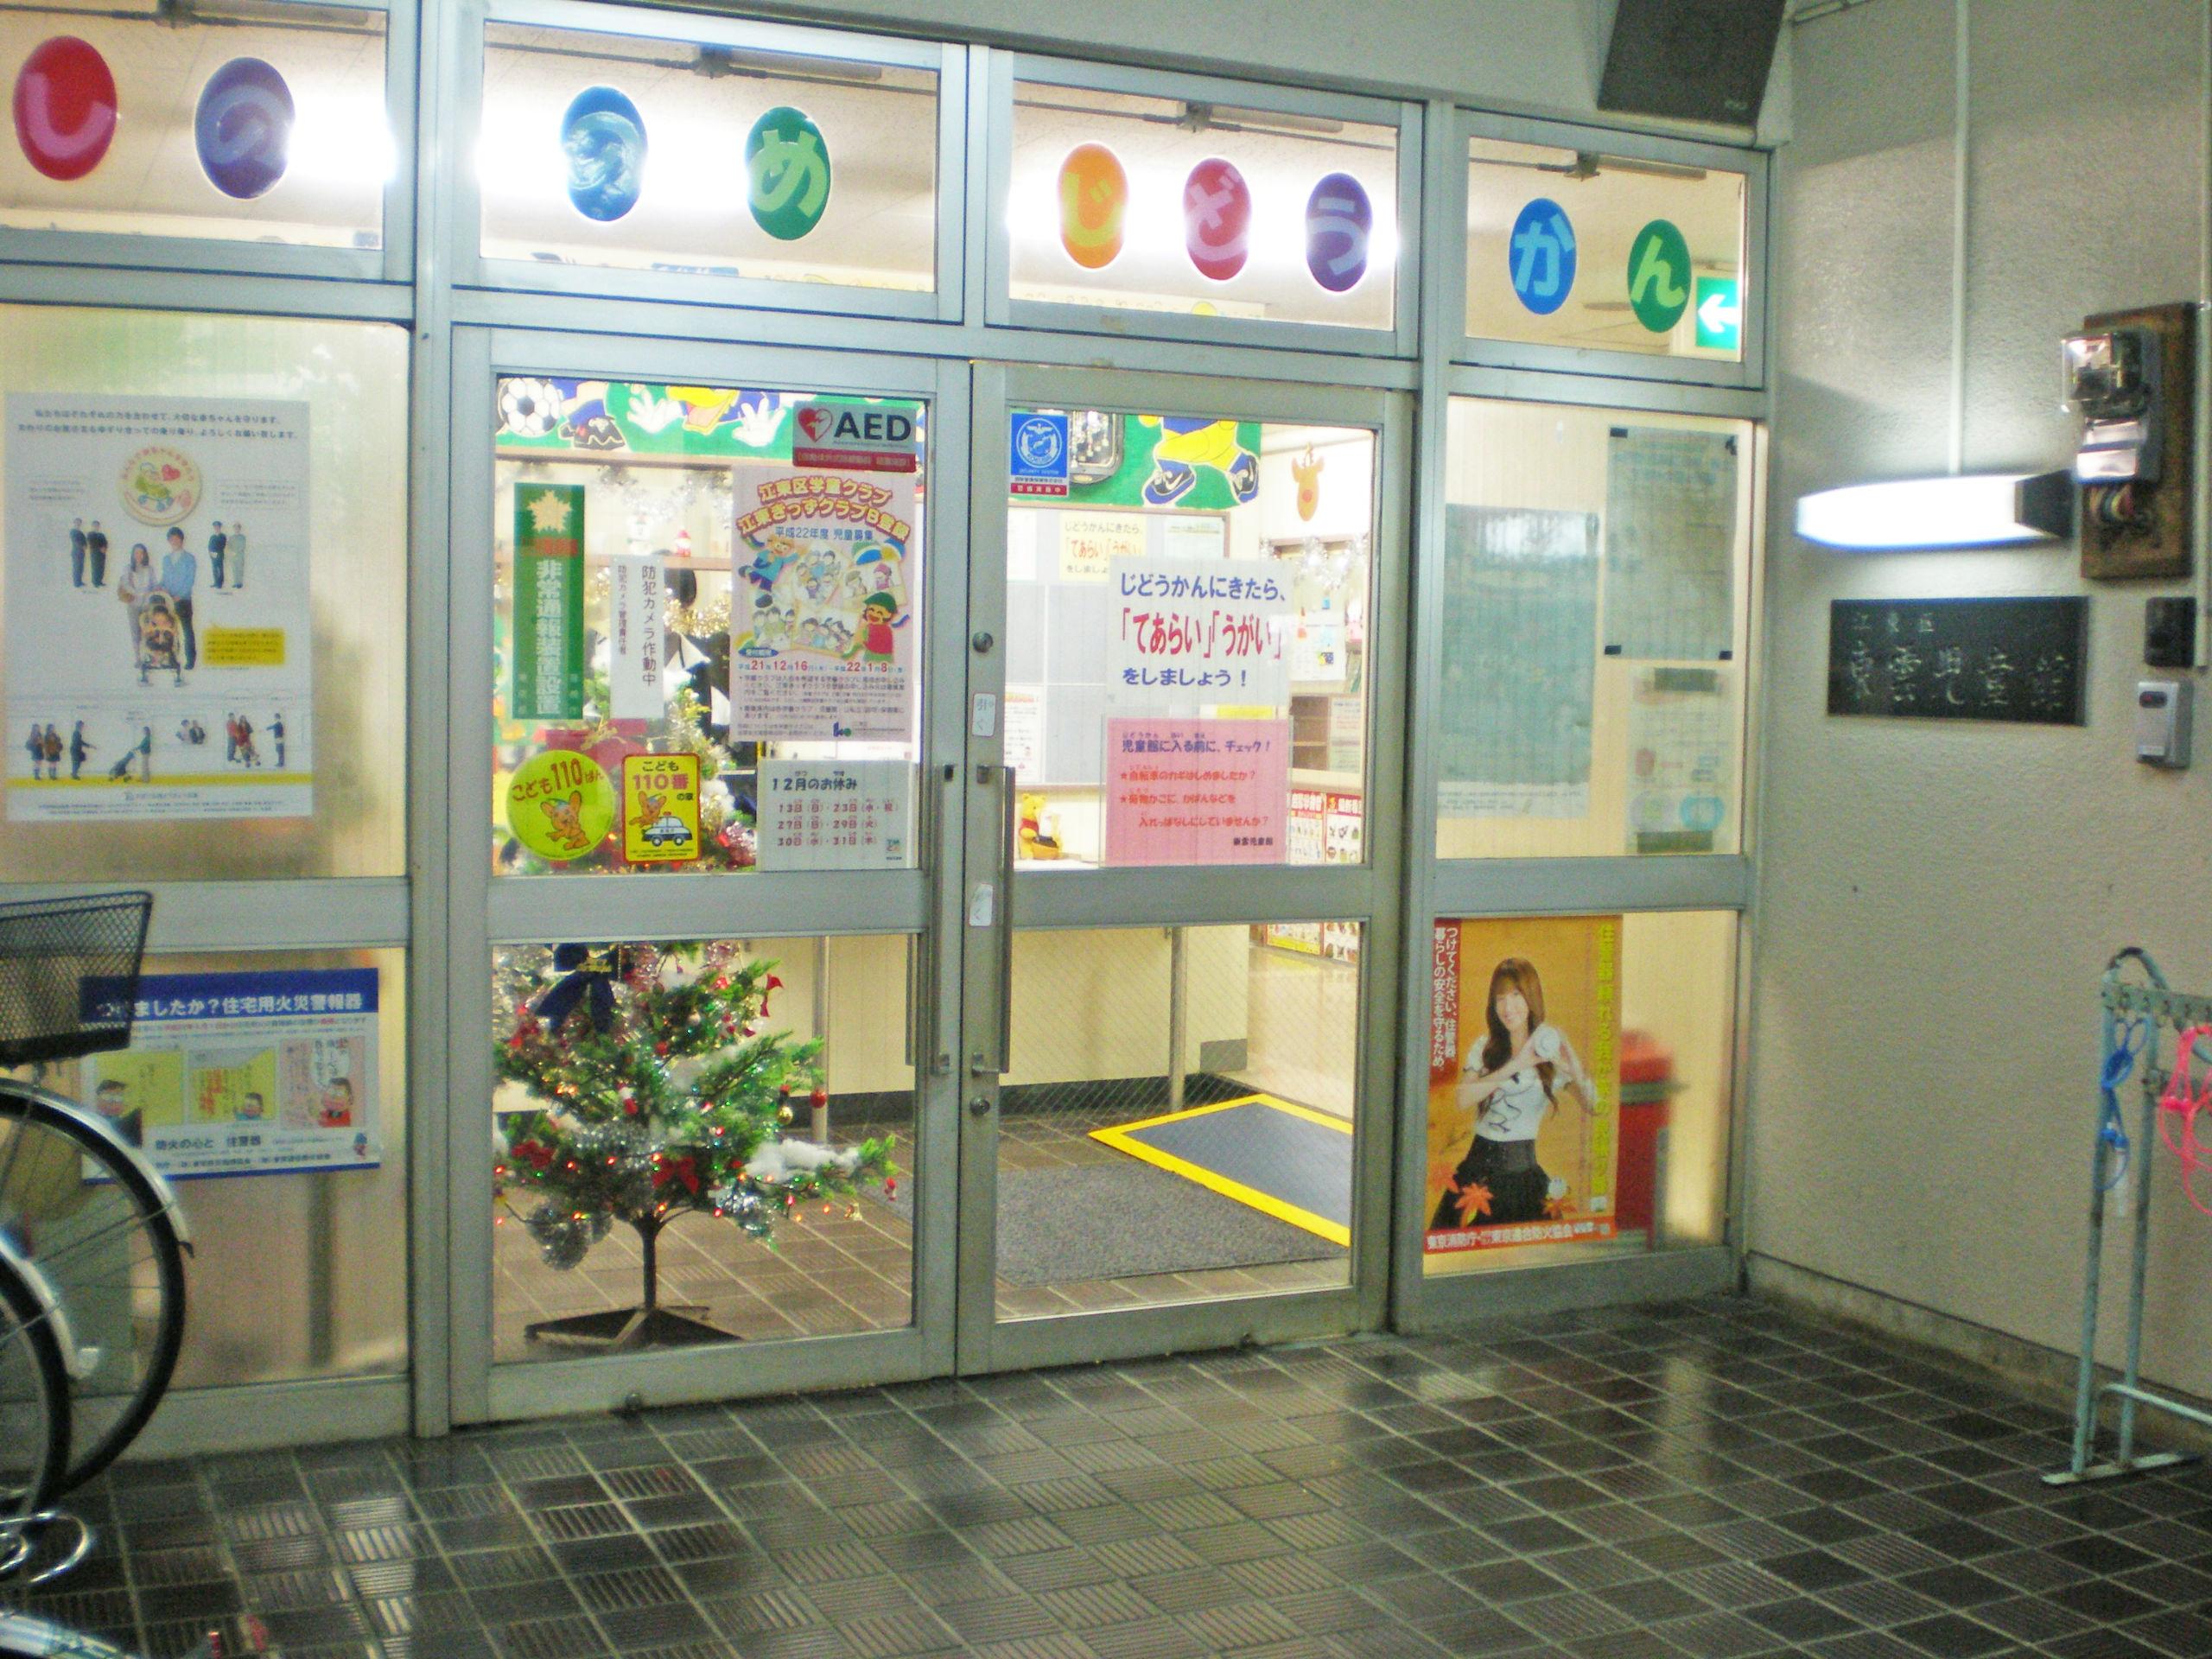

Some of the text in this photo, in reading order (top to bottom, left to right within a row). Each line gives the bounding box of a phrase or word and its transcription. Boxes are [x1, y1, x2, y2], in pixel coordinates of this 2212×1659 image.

[834, 411, 912, 441] AED
[775, 526, 830, 540] 平成22年度
[1121, 573, 1285, 601] じどうかんにきたら、
[641, 565, 657, 687] 防犯カメラ作動中
[1122, 607, 1281, 659] 「てあらい」「うがい」
[1122, 667, 1246, 686] をしましょう！
[643, 760, 679, 772] こども
[633, 774, 689, 790] 110番
[772, 778, 858, 791] 12月のお休み
